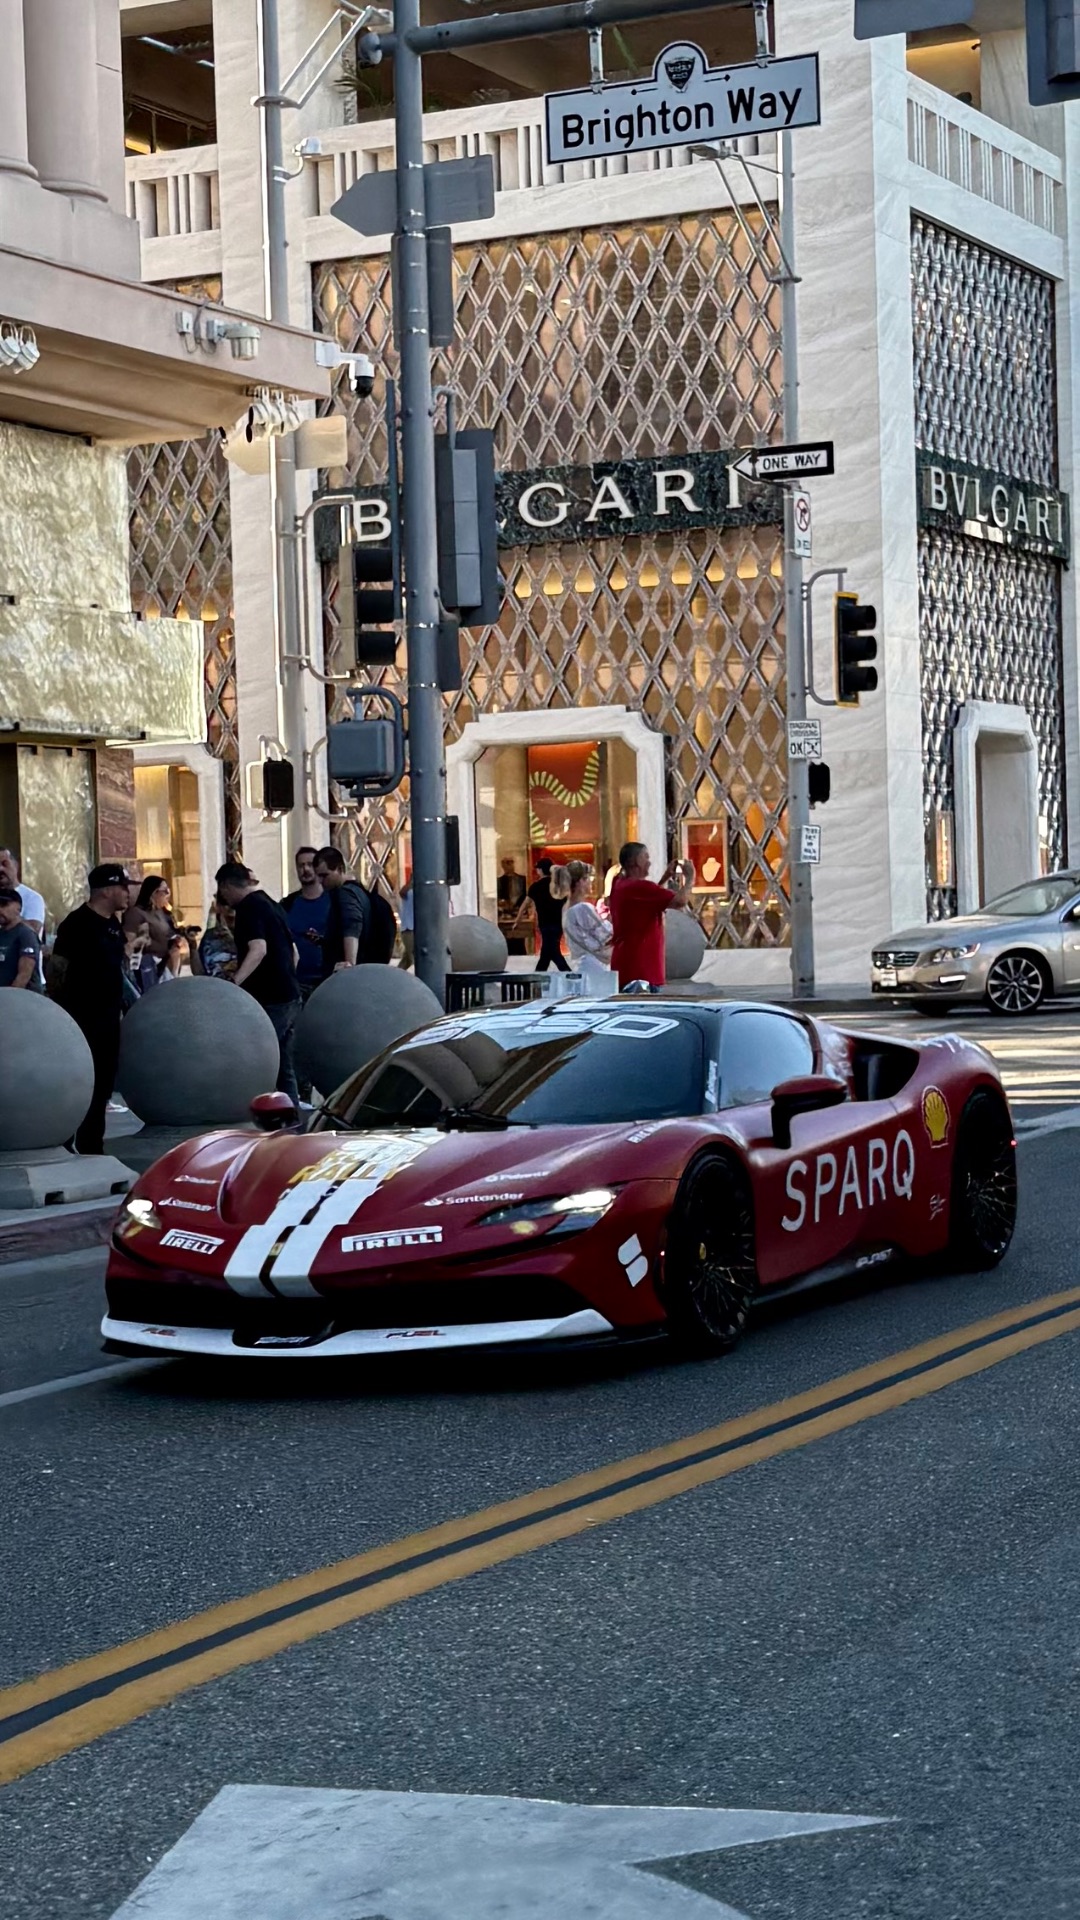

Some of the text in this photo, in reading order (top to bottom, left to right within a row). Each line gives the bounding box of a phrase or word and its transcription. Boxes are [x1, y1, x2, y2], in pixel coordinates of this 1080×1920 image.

[563, 87, 802, 148] Brighton Way
[762, 453, 821, 471] ONE WAY
[352, 465, 743, 542] BGARI
[930, 466, 1063, 543] BVLGARI
[790, 742, 803, 755] OK
[445, 1193, 524, 1205] Santander
[781, 1129, 915, 1232] SPARQ
[341, 1225, 443, 1252] PIRELLI
